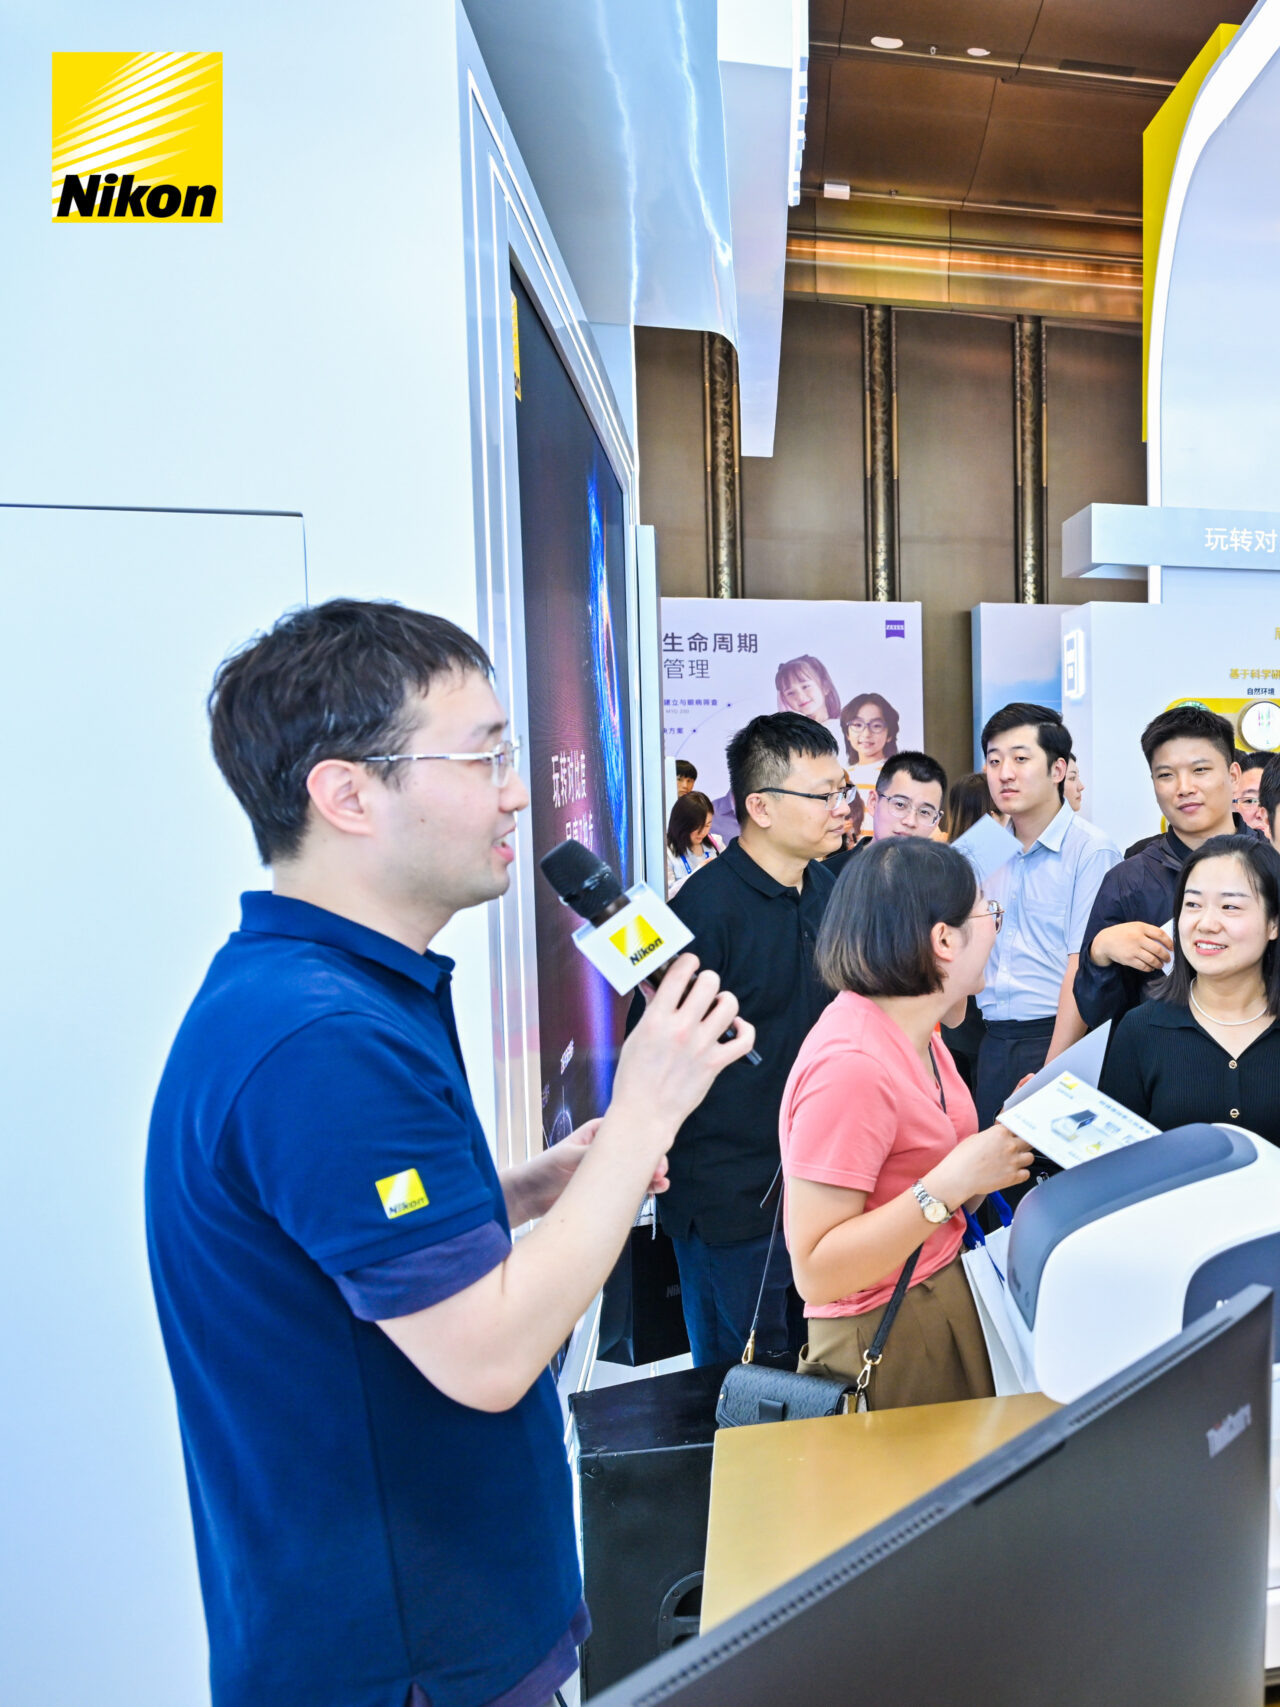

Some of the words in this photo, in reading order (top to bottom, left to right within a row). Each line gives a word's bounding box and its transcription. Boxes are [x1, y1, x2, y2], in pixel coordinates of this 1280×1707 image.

[662, 632, 758, 653] 生命周期
[664, 658, 711, 680] 管理
[629, 937, 663, 967] Nikon
